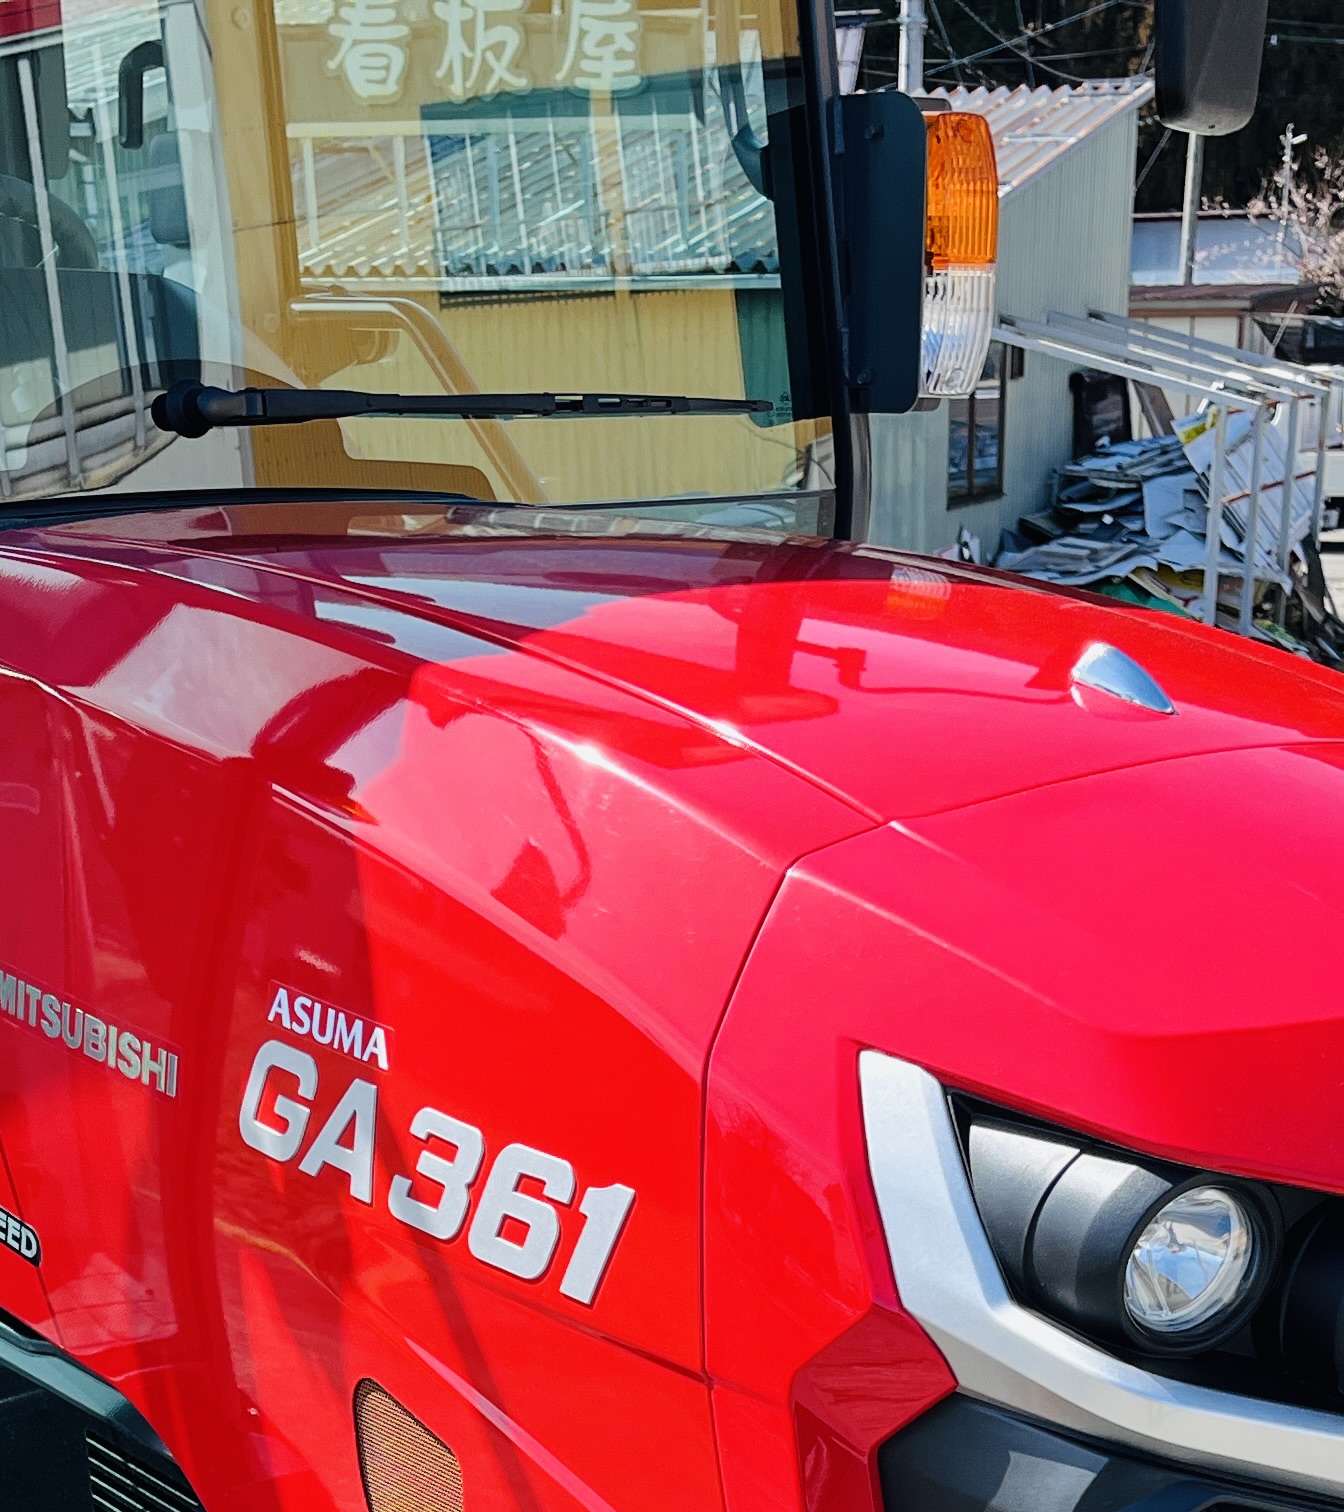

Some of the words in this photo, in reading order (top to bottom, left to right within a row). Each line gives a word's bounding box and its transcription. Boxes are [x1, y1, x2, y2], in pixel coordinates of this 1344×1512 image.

[326, 0, 642, 98] 看板屋
[268, 988, 389, 1070] ASUMA
